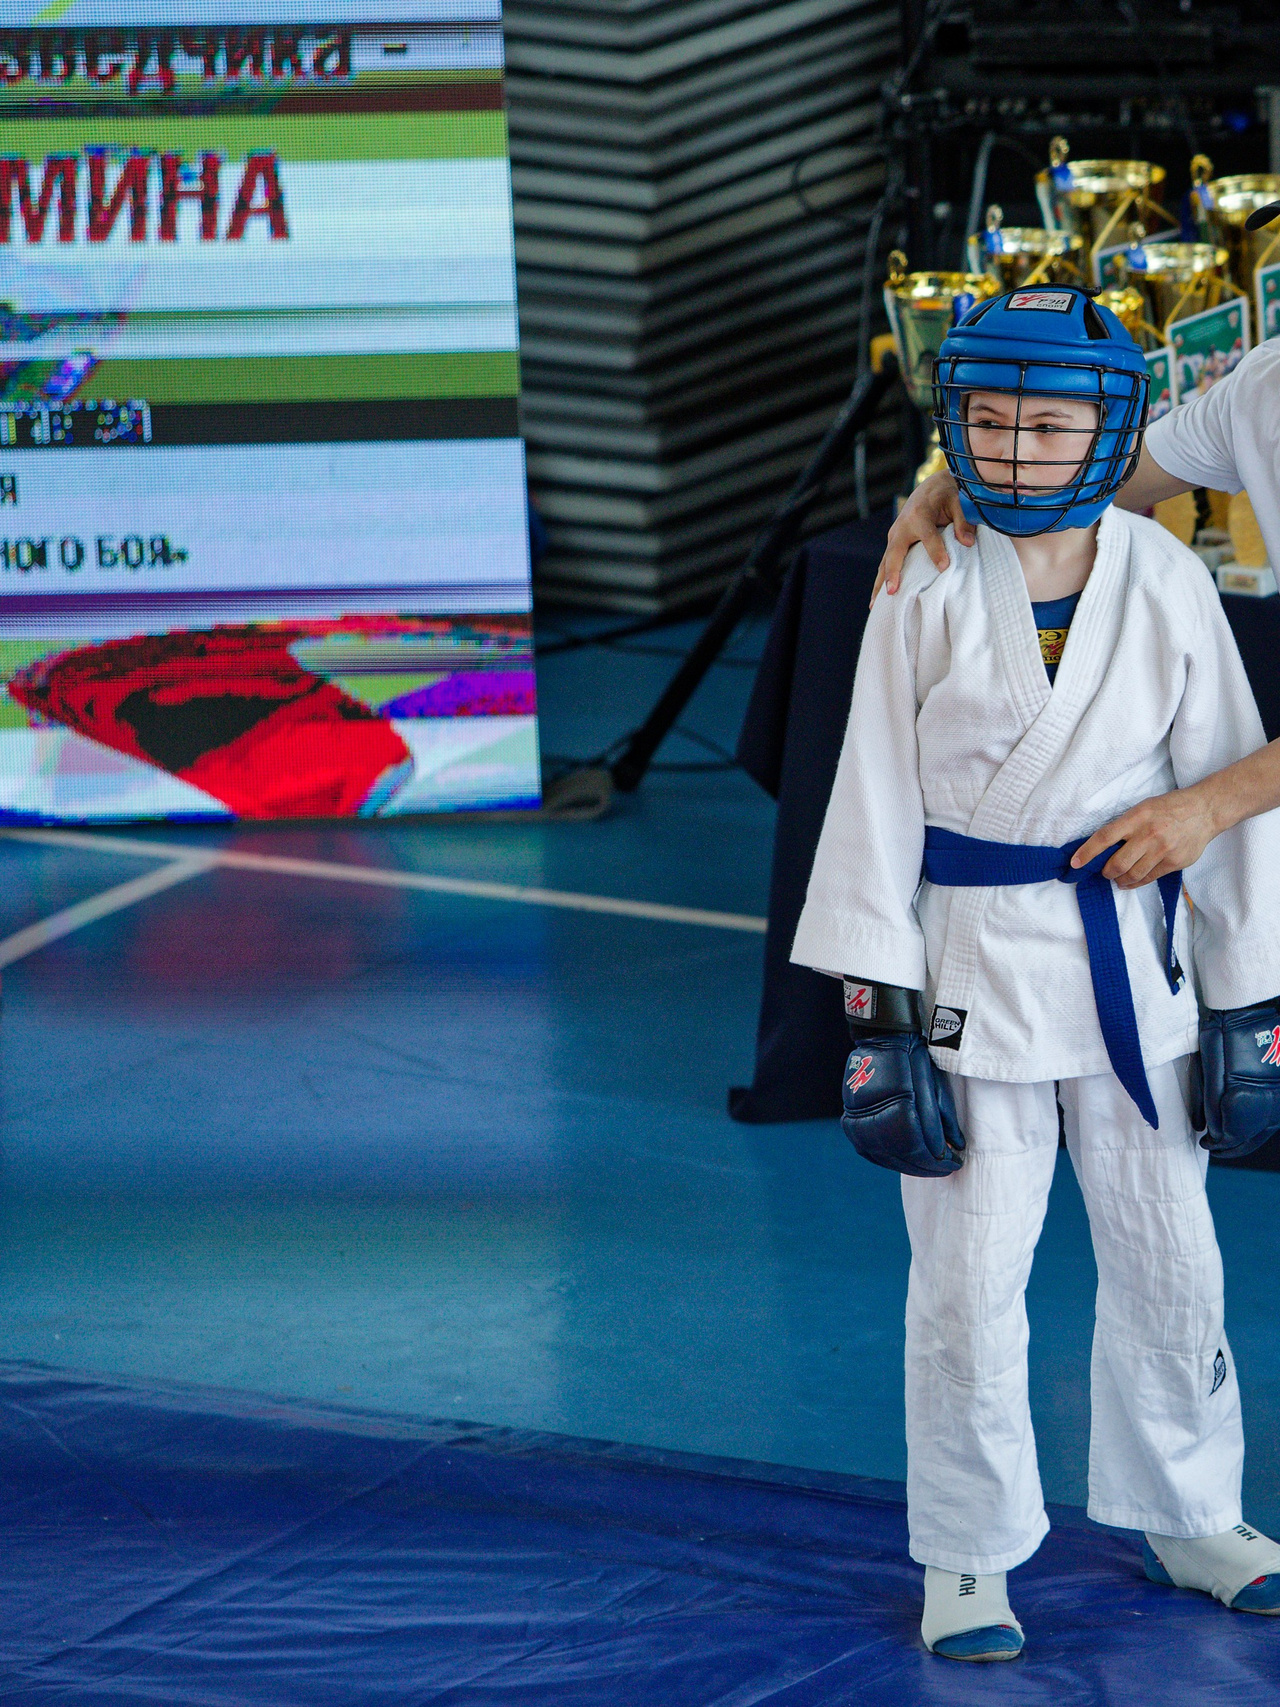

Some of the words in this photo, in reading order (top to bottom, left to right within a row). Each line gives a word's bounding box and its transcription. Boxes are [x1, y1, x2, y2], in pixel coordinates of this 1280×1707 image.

[935, 1017, 961, 1026] GREEN
[935, 1023, 956, 1031] HILL
[958, 1573, 976, 1596] HU
